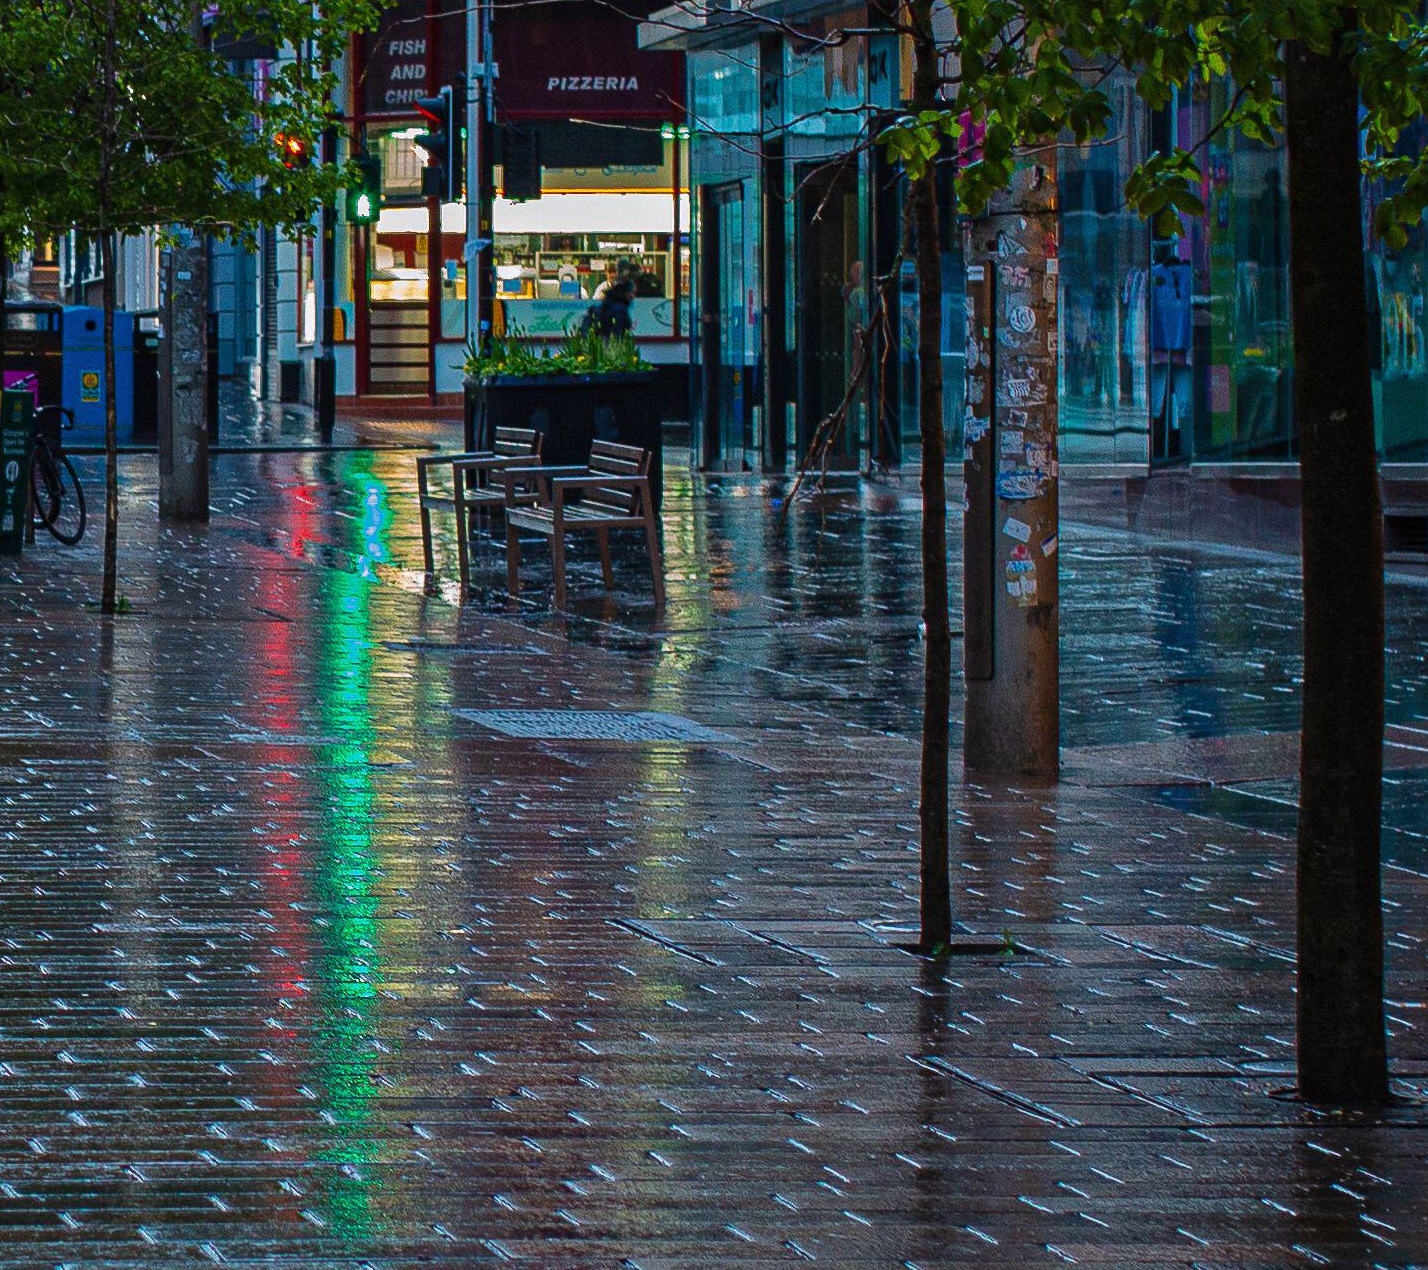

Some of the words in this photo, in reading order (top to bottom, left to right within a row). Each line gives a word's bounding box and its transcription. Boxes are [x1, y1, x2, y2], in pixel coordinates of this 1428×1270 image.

[389, 41, 426, 56] FISH
[390, 64, 426, 81] AND
[547, 76, 639, 91] PIZZERIA
[384, 89, 429, 105] CHIP
